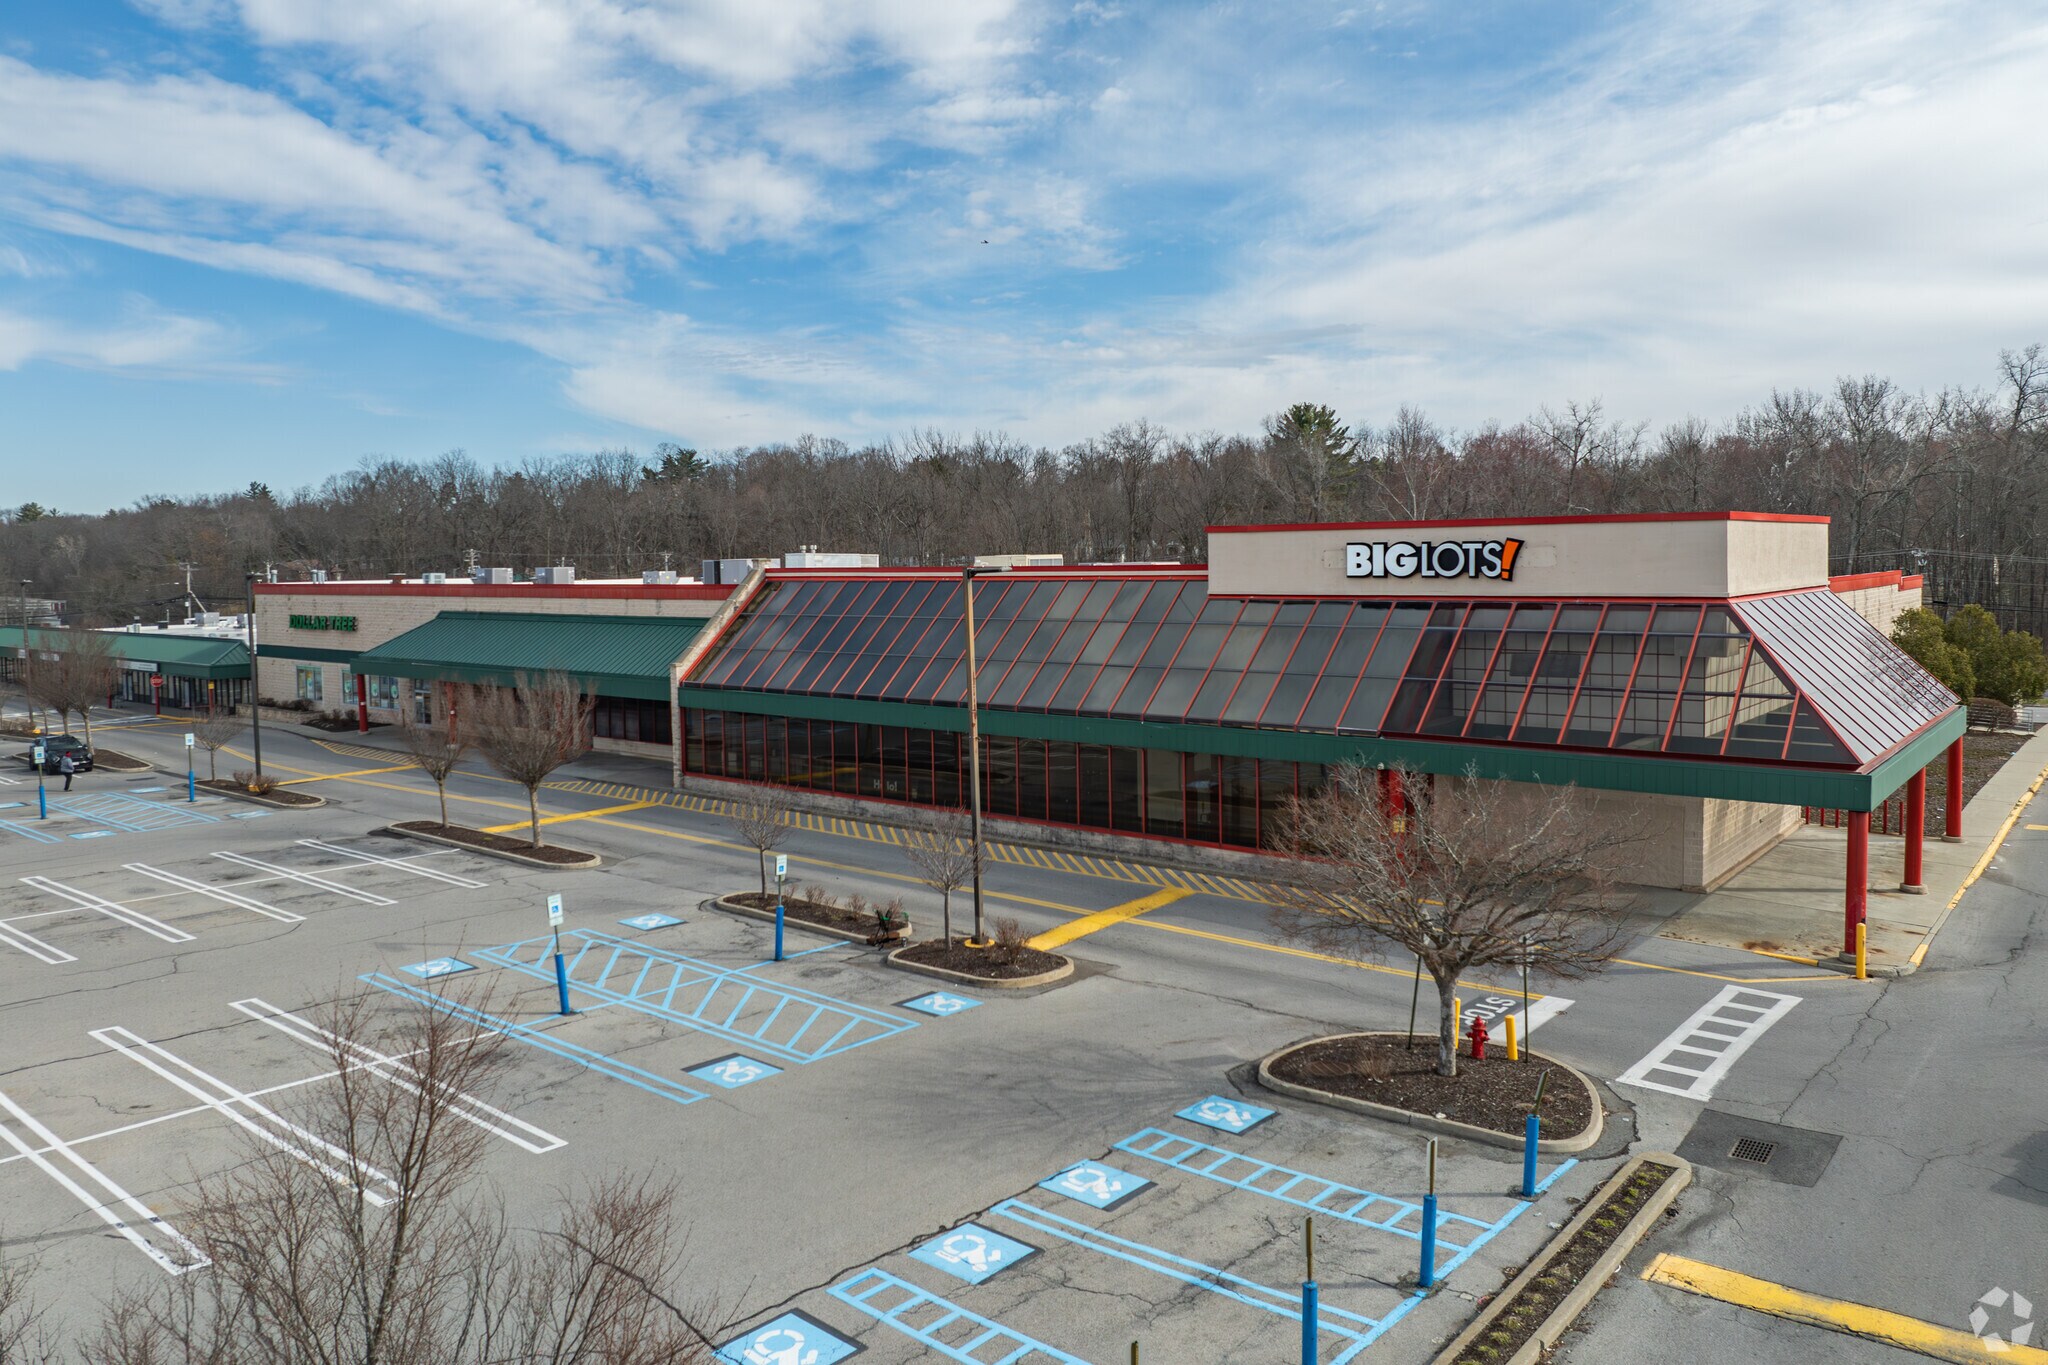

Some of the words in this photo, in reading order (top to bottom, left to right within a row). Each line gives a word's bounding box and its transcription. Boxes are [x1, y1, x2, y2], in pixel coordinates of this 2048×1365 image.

[1346, 542, 1418, 577] BIG
[1421, 538, 1523, 580] LOTS!
[289, 615, 327, 630] DOLLAR
[328, 616, 355, 632] TREE
[873, 779, 898, 791] Hlo!
